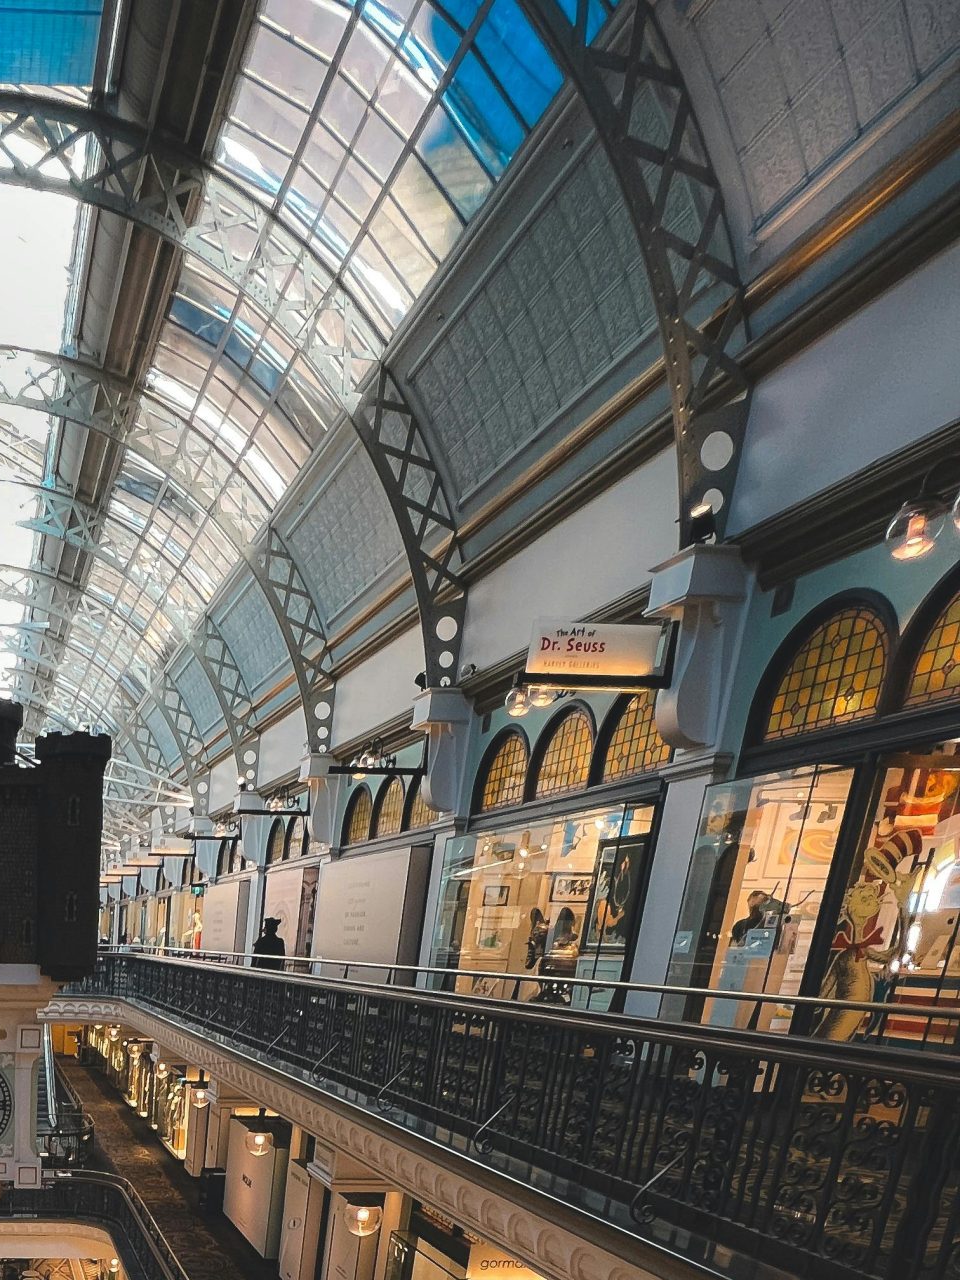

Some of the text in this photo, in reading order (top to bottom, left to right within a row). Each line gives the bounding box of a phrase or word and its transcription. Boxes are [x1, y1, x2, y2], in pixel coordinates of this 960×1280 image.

[556, 629, 568, 637] The
[570, 627, 585, 637] Art
[541, 637, 606, 652] Dr. Seuss
[480, 1259, 528, 1271] gorma
